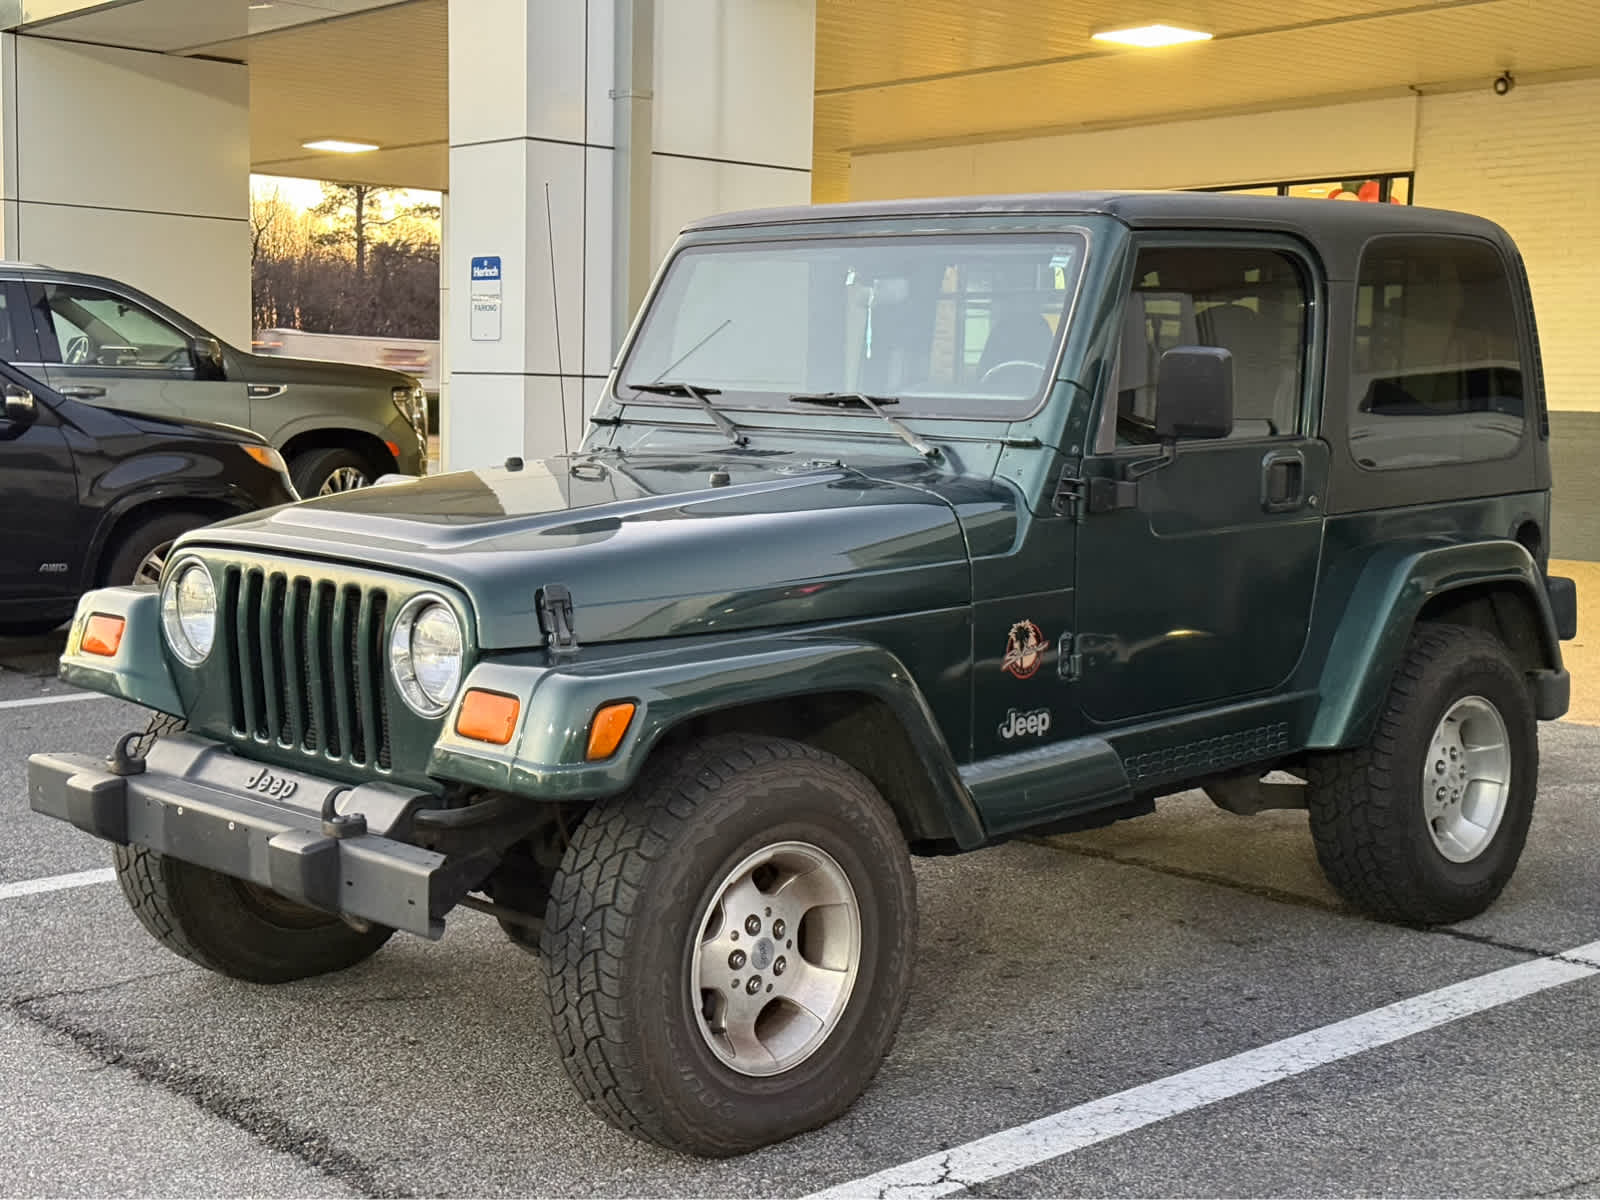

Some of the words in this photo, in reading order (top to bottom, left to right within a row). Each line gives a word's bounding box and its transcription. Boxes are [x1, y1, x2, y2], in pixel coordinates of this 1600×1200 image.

[39, 563, 68, 572] AWD
[1001, 710, 1050, 739] Jeep
[245, 768, 298, 800] Jeep
